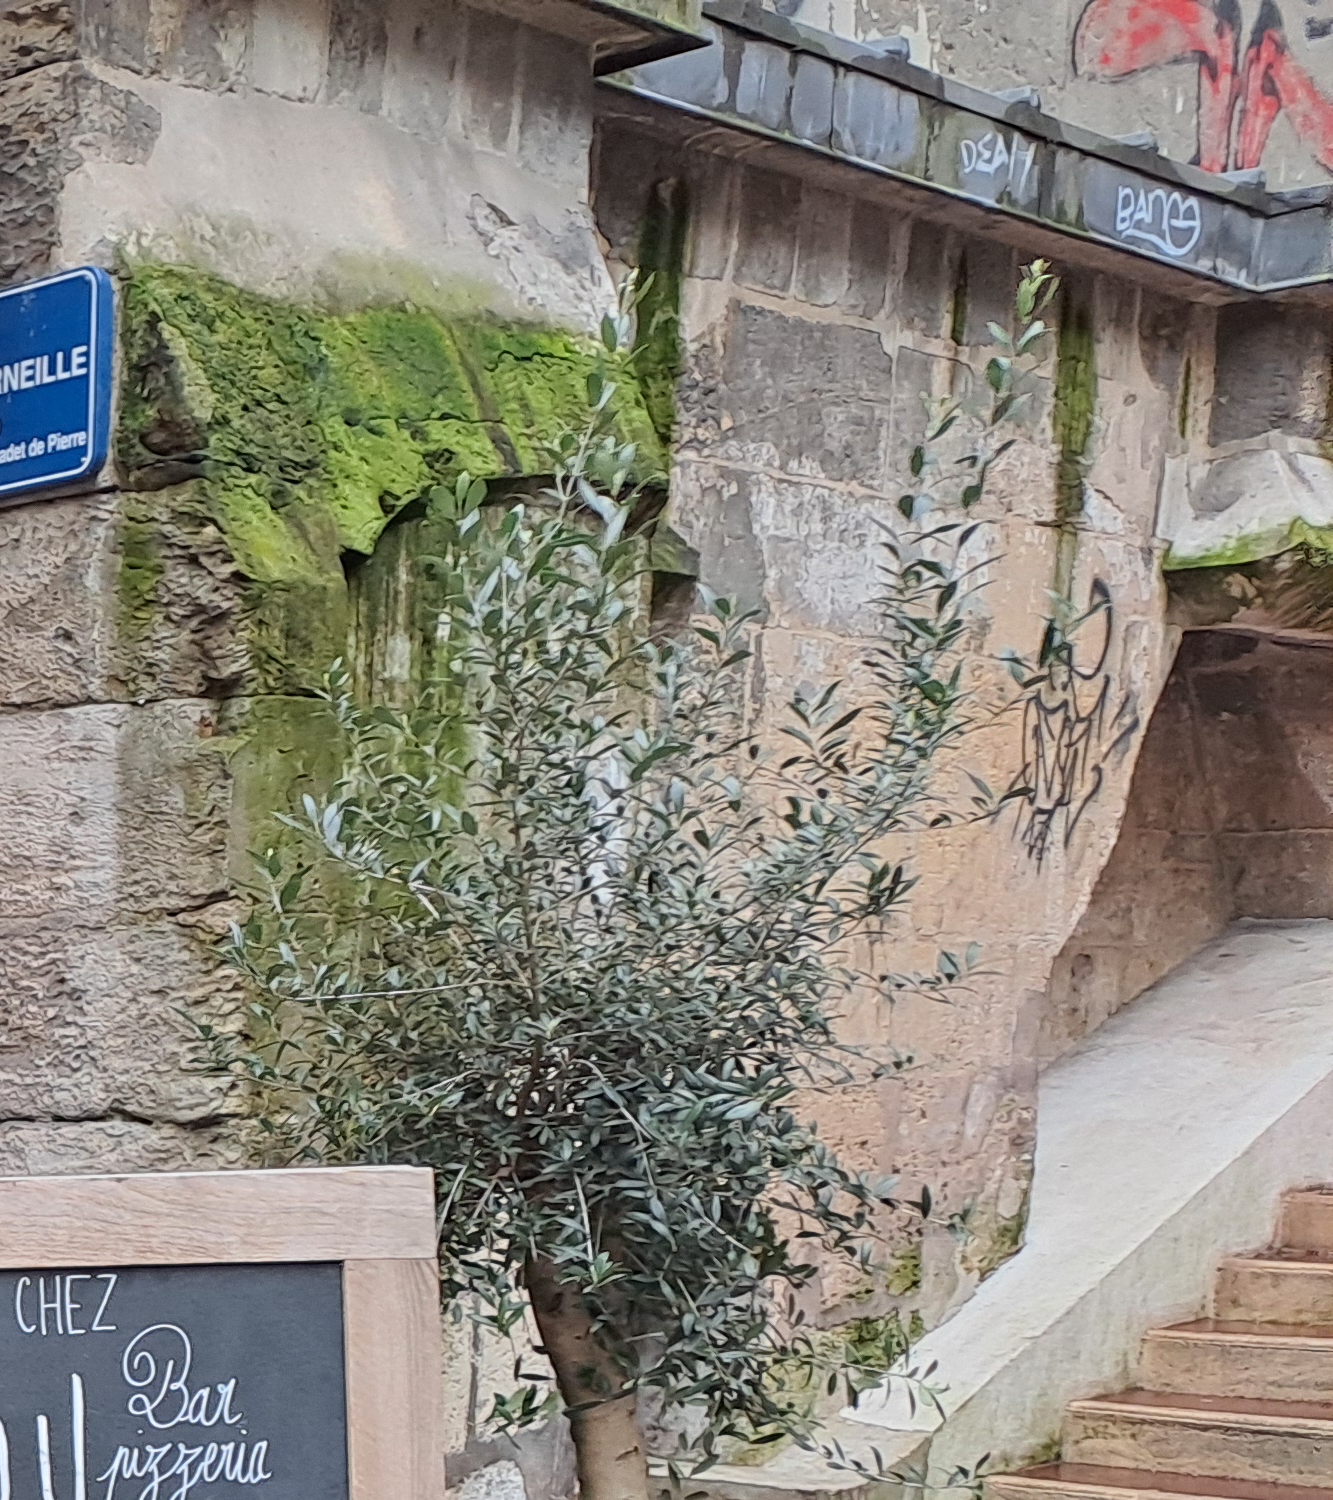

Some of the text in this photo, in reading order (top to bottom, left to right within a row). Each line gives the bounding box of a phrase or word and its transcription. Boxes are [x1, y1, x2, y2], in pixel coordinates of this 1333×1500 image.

[27, 440, 45, 457] de
[47, 430, 87, 454] Pierre
[15, 1273, 118, 1336] CHEZ
[122, 1323, 244, 1429] Bar
